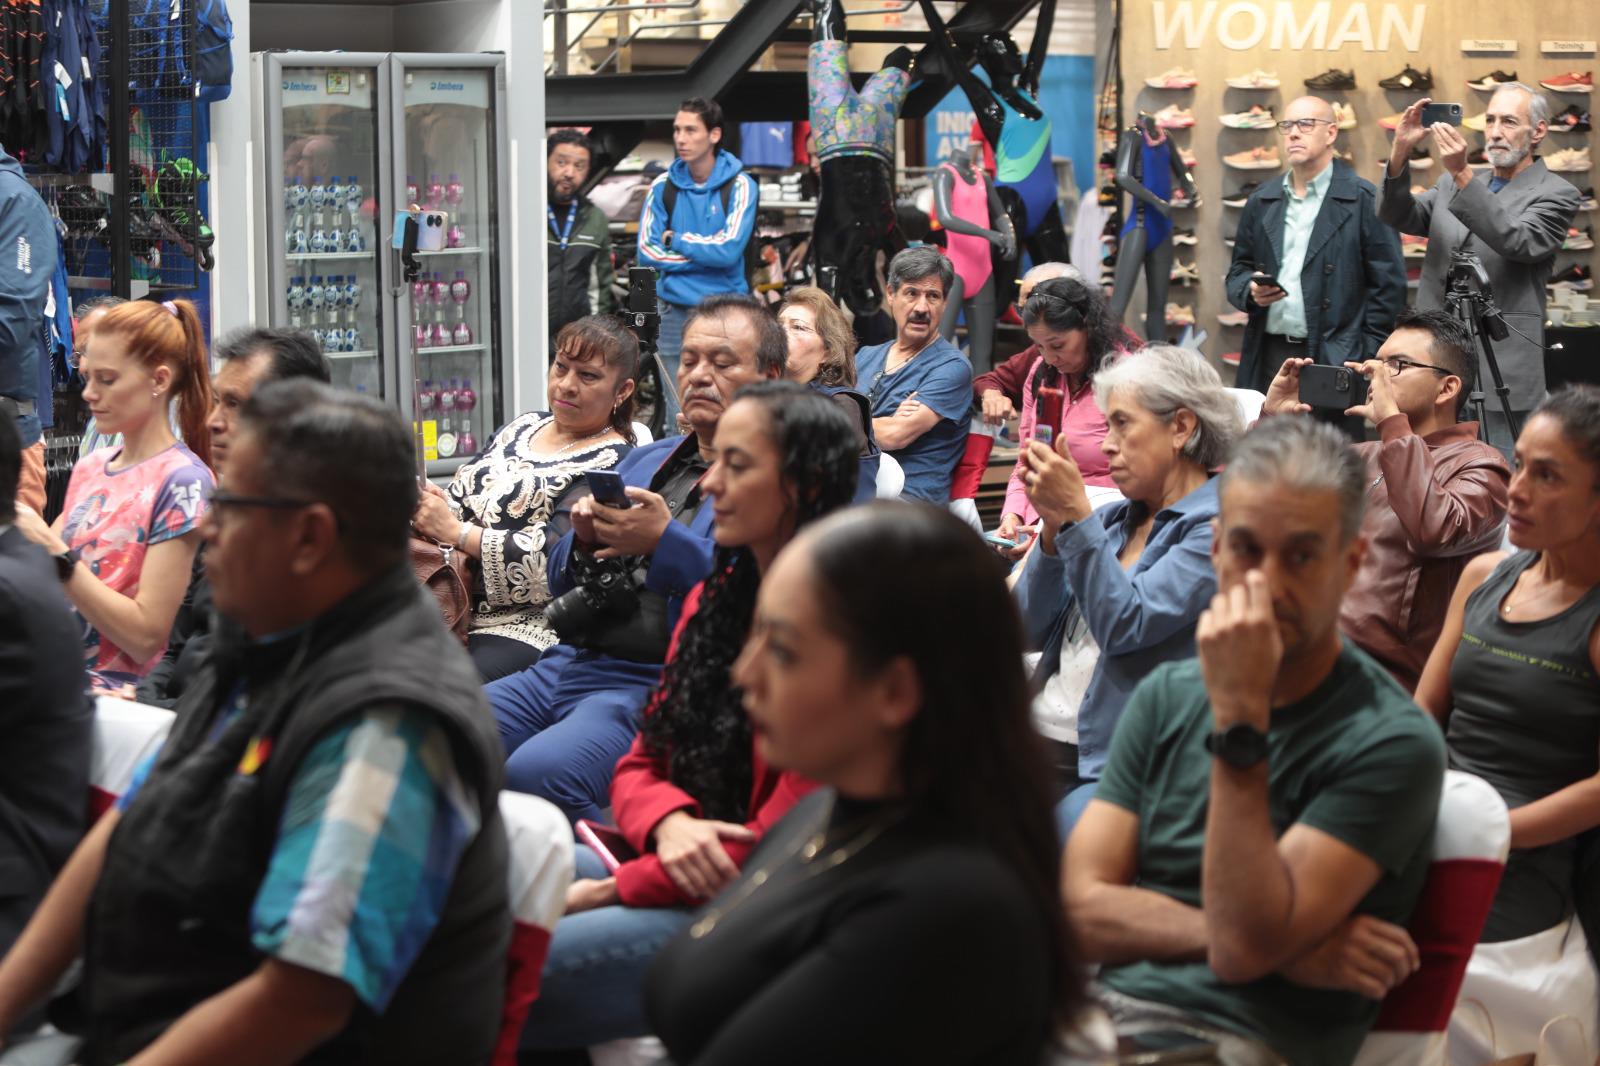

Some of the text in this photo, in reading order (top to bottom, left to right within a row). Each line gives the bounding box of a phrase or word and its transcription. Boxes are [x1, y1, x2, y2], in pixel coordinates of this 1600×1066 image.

[1152, 0, 1427, 52] WOMAN
[1474, 40, 1505, 50] Training
[1553, 41, 1585, 51] Training
[437, 82, 464, 91] Imbera
